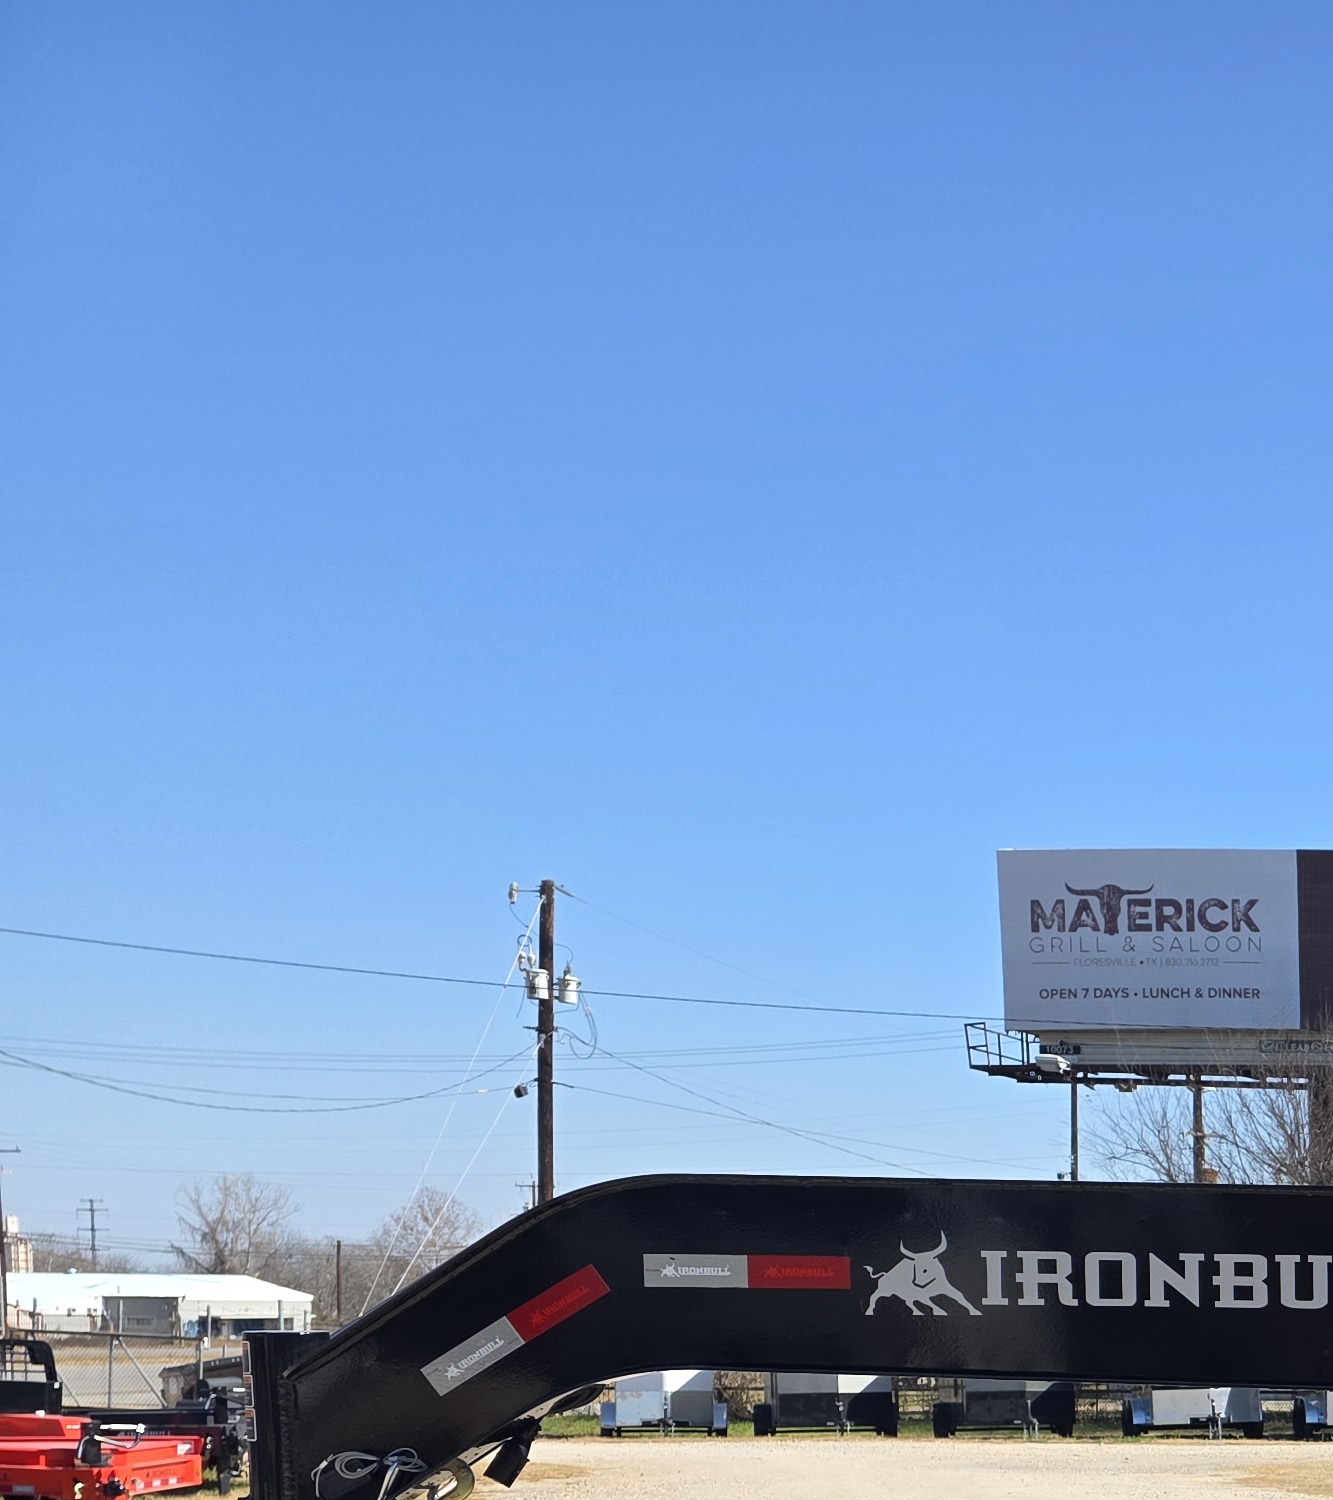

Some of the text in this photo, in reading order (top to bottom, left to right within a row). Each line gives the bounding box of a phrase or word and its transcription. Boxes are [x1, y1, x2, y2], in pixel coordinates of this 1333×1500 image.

[1029, 936, 1262, 953] GRILL & SALOON
[1039, 987, 1260, 999] OPEN 7 DAYS LUNCH & DINNER
